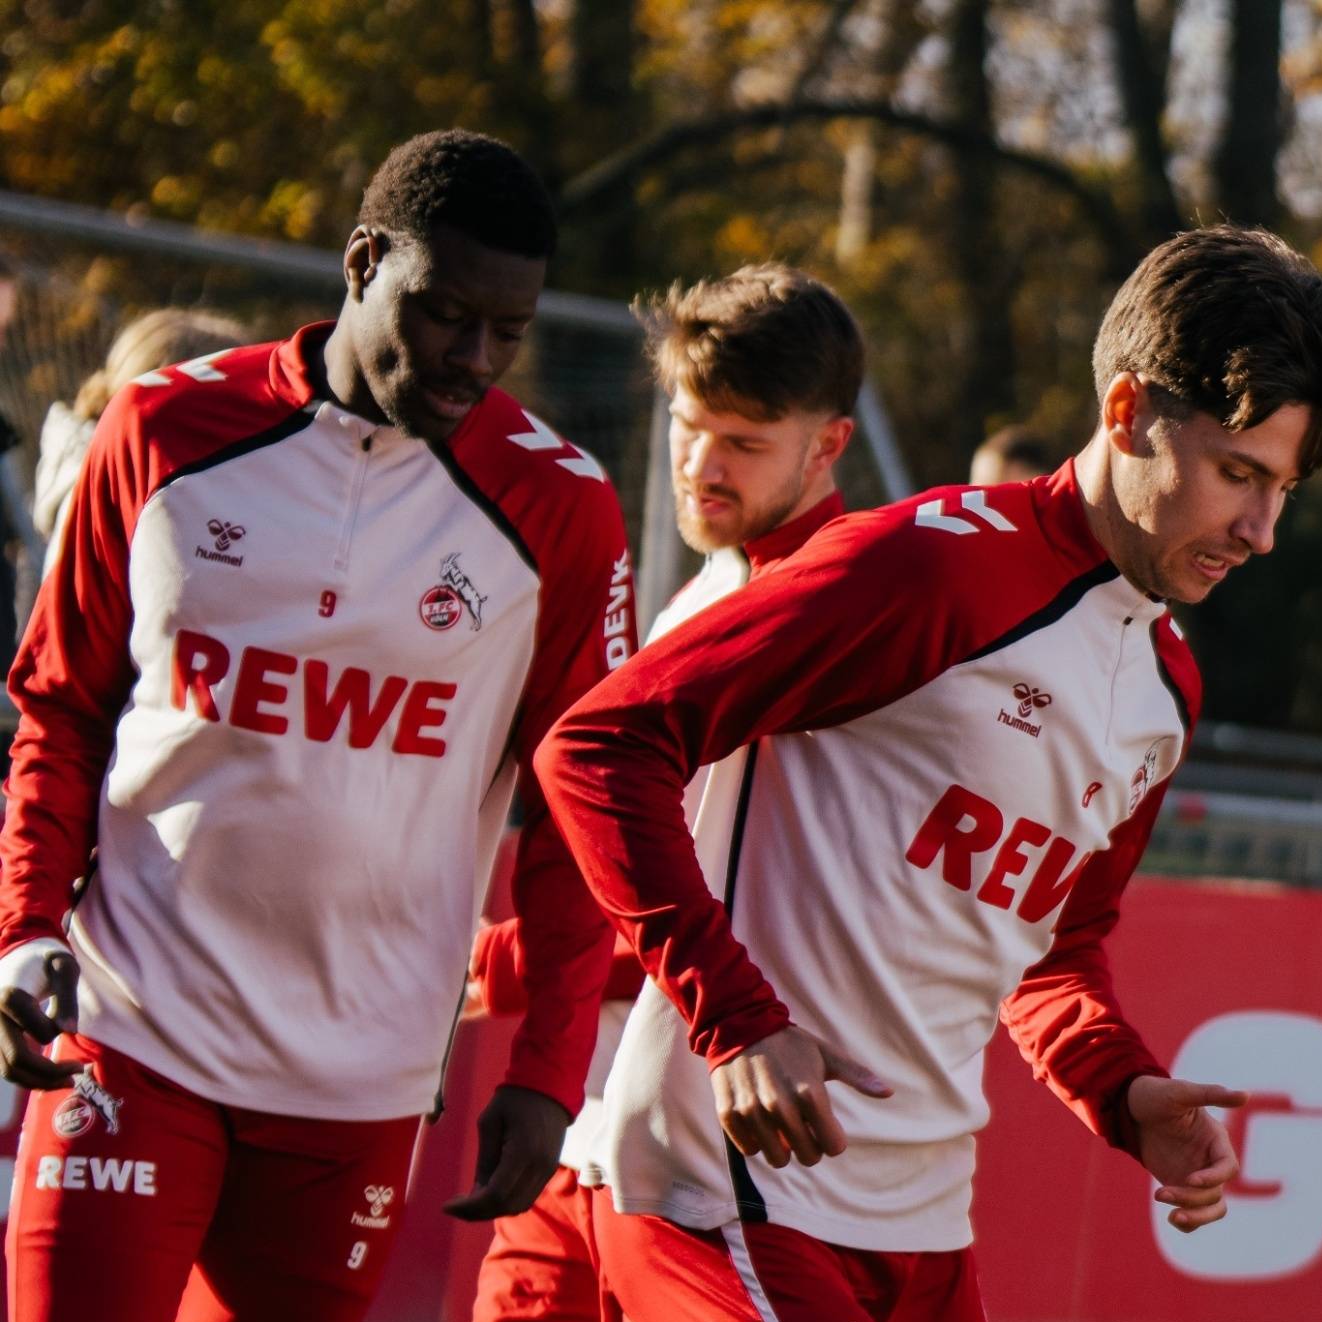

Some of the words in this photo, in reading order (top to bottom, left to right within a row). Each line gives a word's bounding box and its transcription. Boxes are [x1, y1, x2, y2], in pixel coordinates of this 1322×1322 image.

[195, 545, 244, 567] hummel
[318, 590, 337, 617] 9
[603, 548, 629, 670] DEVK
[170, 628, 457, 758] REWE
[997, 708, 1042, 738] hummel
[36, 1155, 157, 1195] REWE
[347, 1241, 368, 1269] 9
